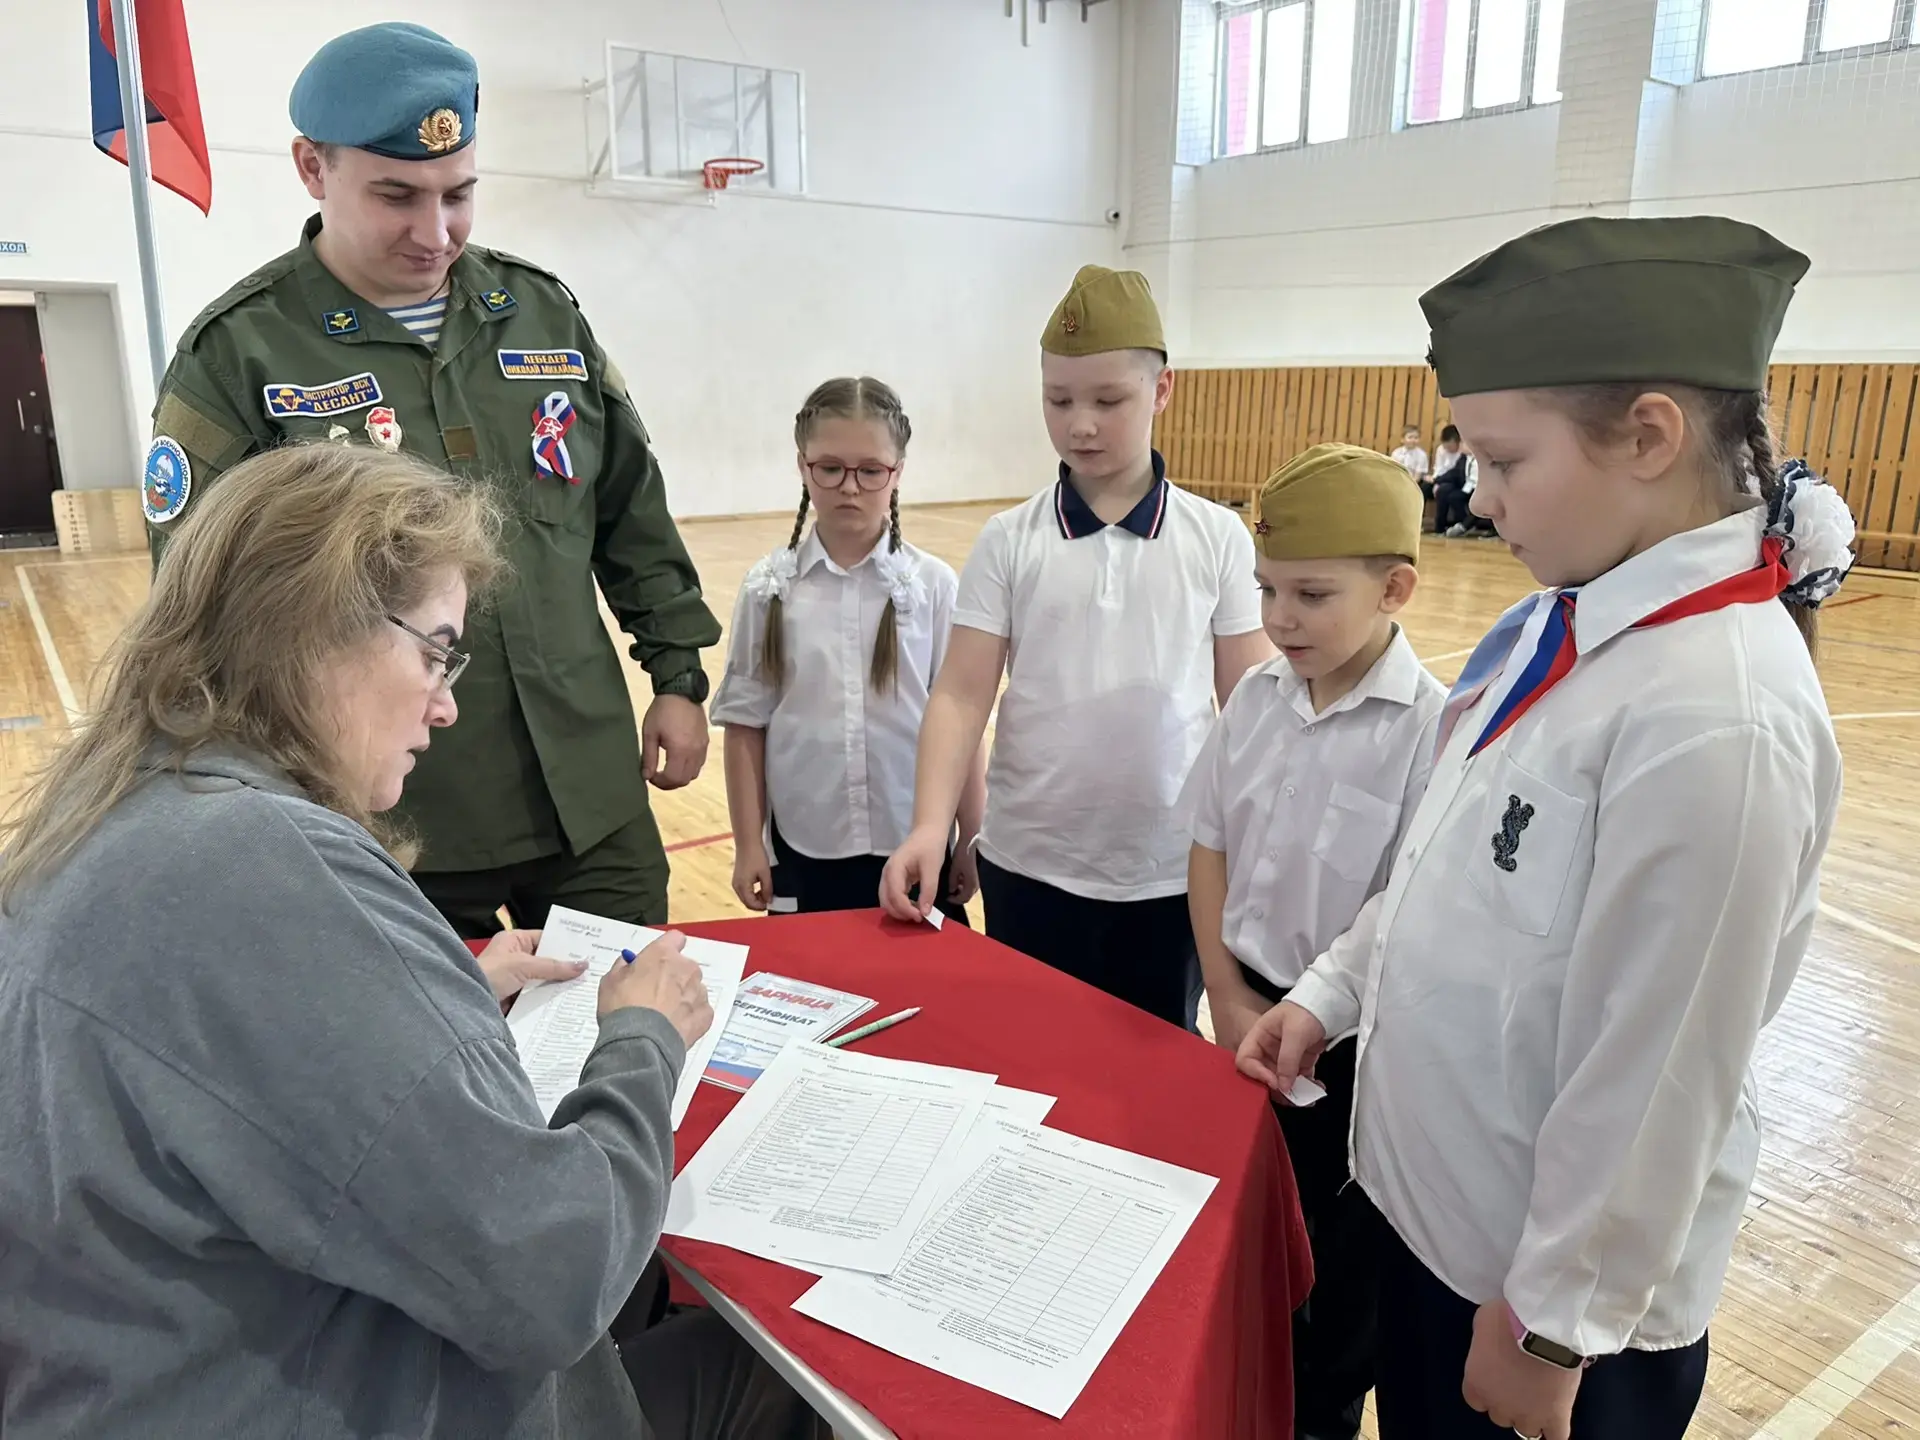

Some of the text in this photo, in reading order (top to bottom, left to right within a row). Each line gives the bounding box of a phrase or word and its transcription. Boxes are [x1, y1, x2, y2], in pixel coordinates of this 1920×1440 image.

[505, 364, 541, 374] НИКОЛАЙ
[523, 354, 568, 364] ЛЕБЕДЕВ
[302, 378, 370, 401] ИНСТРУКТОР ВСК
[744, 985, 836, 1011] ЗАРНИЦА
[733, 999, 818, 1026] СЕРТИФИКАТ
